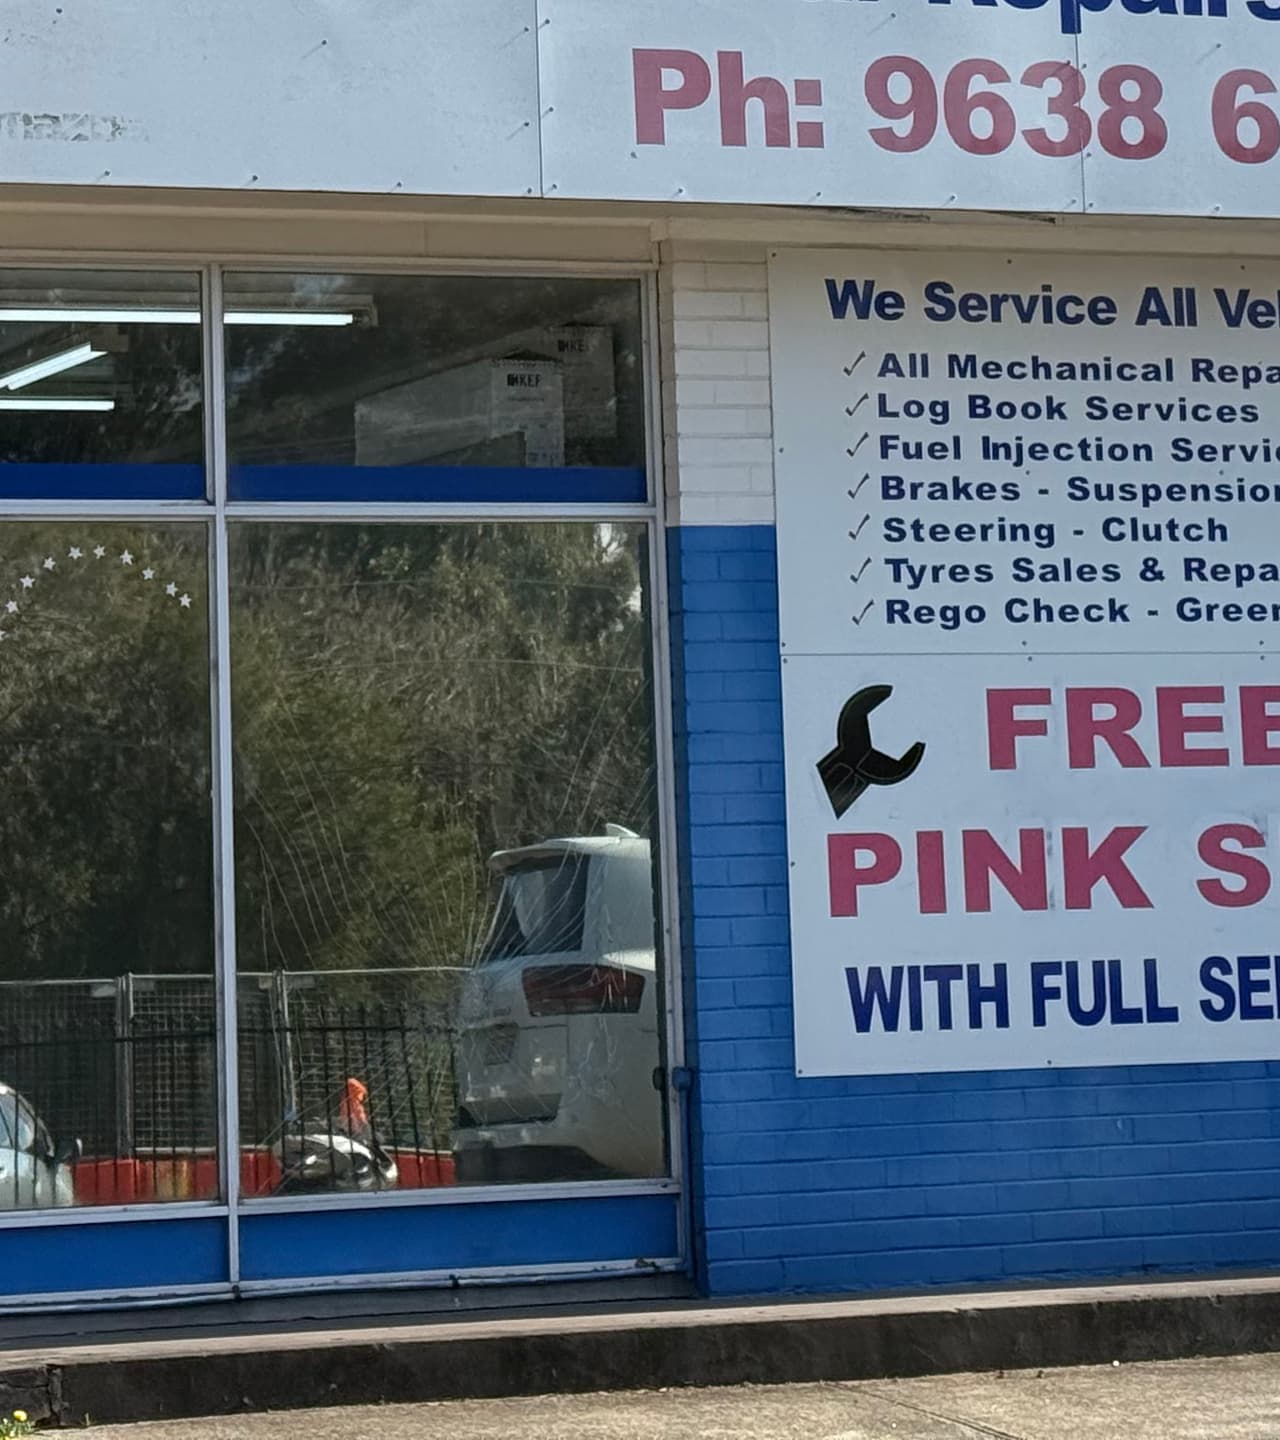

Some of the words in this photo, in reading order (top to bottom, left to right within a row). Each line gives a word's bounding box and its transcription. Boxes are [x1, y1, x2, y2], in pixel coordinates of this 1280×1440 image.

[631, 47, 825, 149] Ph:
[864, 53, 1169, 163] 9638
[823, 278, 906, 321] We
[923, 280, 1118, 326] Service
[1134, 286, 1198, 327] All
[877, 352, 929, 379] All
[947, 353, 1174, 382] Mechanical
[877, 392, 950, 426] Log
[967, 394, 1068, 421] Book
[1085, 395, 1259, 424] Services
[879, 434, 962, 461] Fuel
[981, 435, 1153, 468] Injection
[880, 475, 1021, 502] Brakes
[883, 516, 1055, 549] Steering
[1101, 516, 1228, 542] Clutch
[883, 557, 994, 590] Tyres
[1012, 557, 1121, 583] Sales
[1139, 556, 1166, 582] &
[885, 599, 986, 631] Rego
[1004, 597, 1131, 624] Check
[1147, 609, 1159, 617] -
[827, 825, 1155, 918] PINK
[844, 962, 1010, 1034] WITH
[1030, 958, 1180, 1028] FULL
